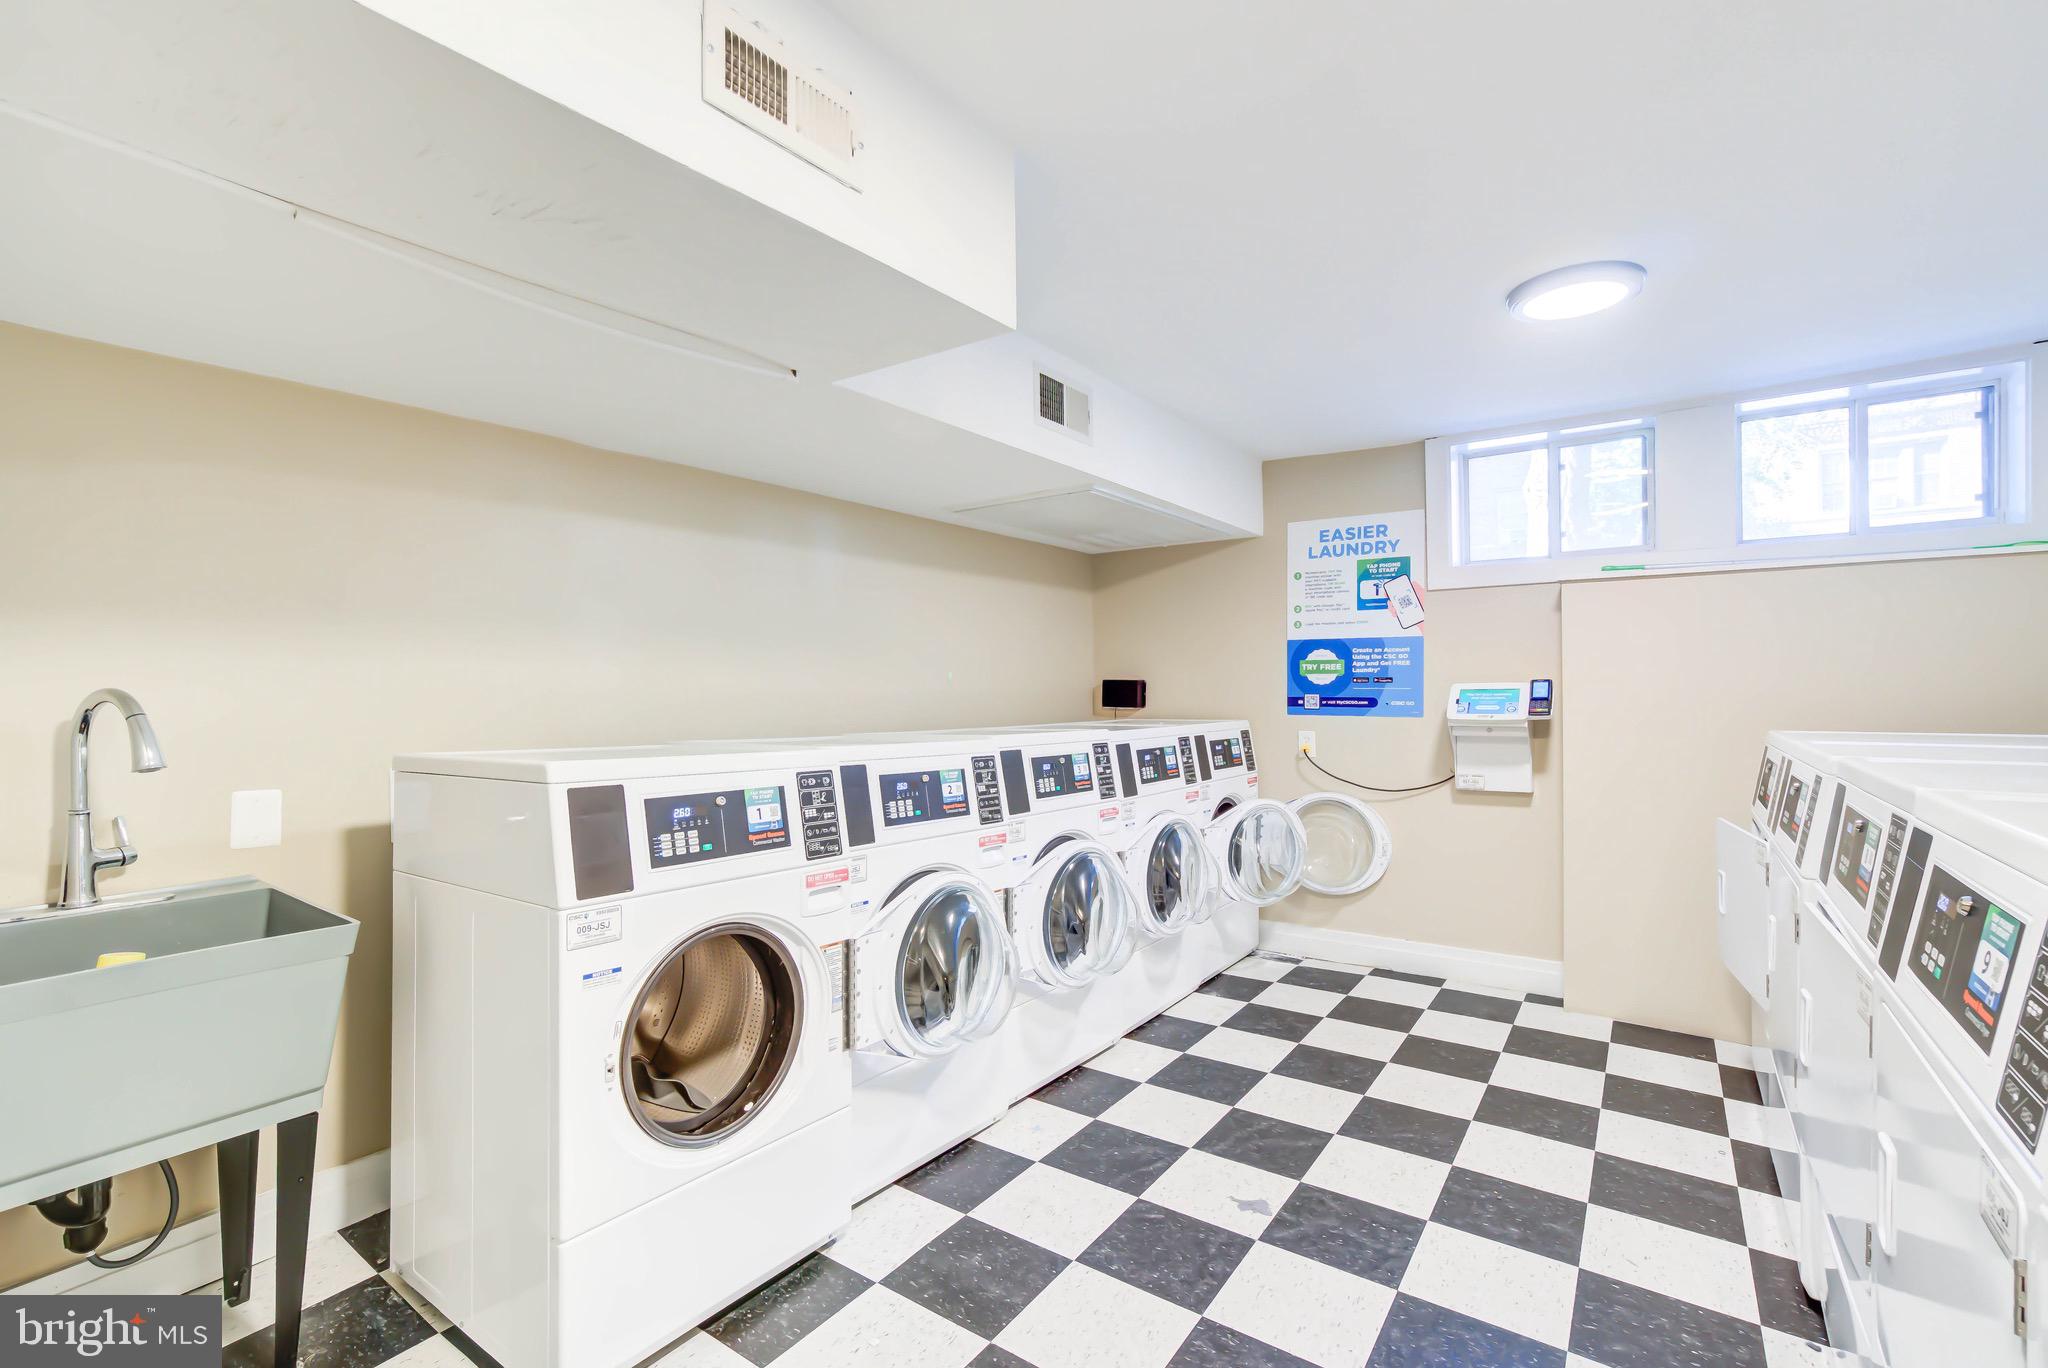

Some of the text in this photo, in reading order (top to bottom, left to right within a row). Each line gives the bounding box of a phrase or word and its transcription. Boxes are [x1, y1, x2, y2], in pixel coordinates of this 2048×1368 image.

[1319, 524, 1389, 543] EASIER
[1308, 539, 1401, 559] LAUNDRY
[1302, 663, 1342, 671] TRY FREE
[947, 784, 953, 795] 2
[756, 808, 762, 820] 1
[576, 921, 611, 935] 009-JSJ
[1981, 950, 1992, 974] 9
